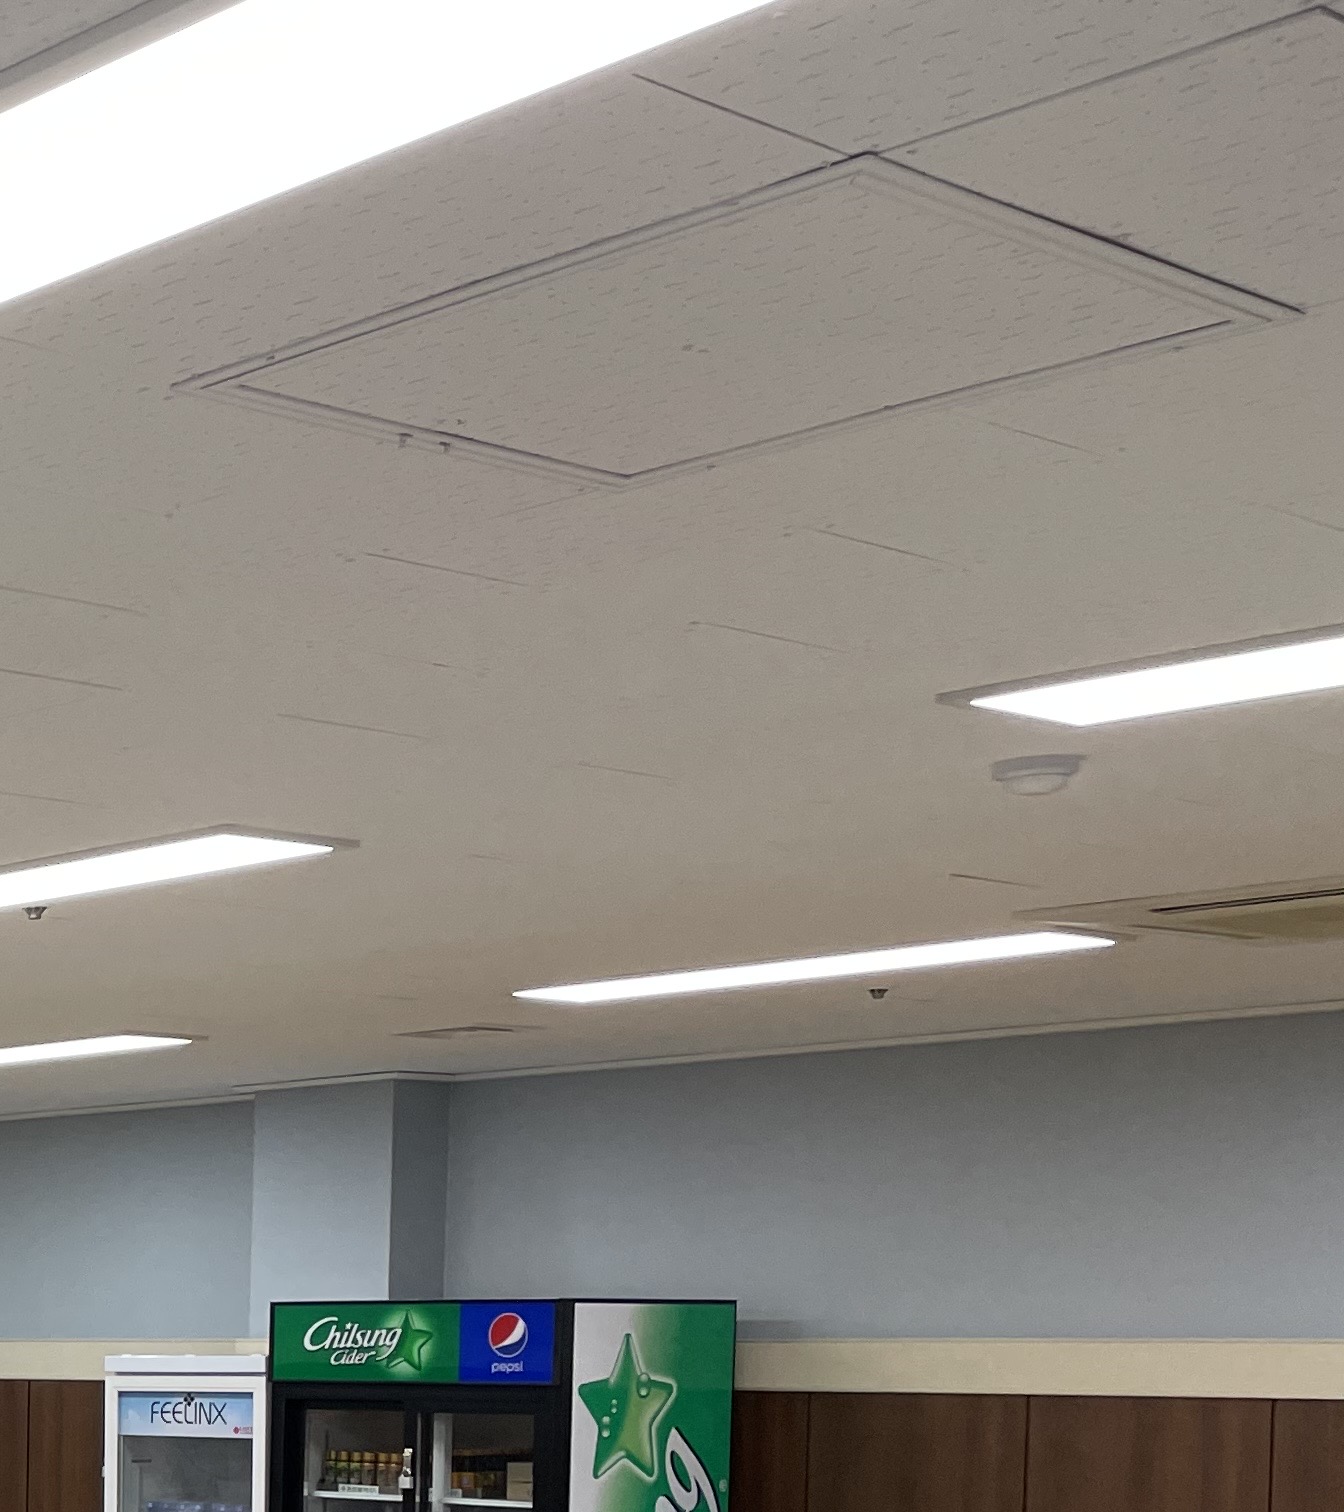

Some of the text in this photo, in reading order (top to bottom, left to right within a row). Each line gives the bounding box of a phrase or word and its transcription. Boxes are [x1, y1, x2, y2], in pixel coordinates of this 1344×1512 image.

[303, 1316, 403, 1361] Chilsung
[330, 1349, 376, 1366] Cider
[491, 1361, 524, 1374] pepsi
[150, 1401, 227, 1425] FEELINX
